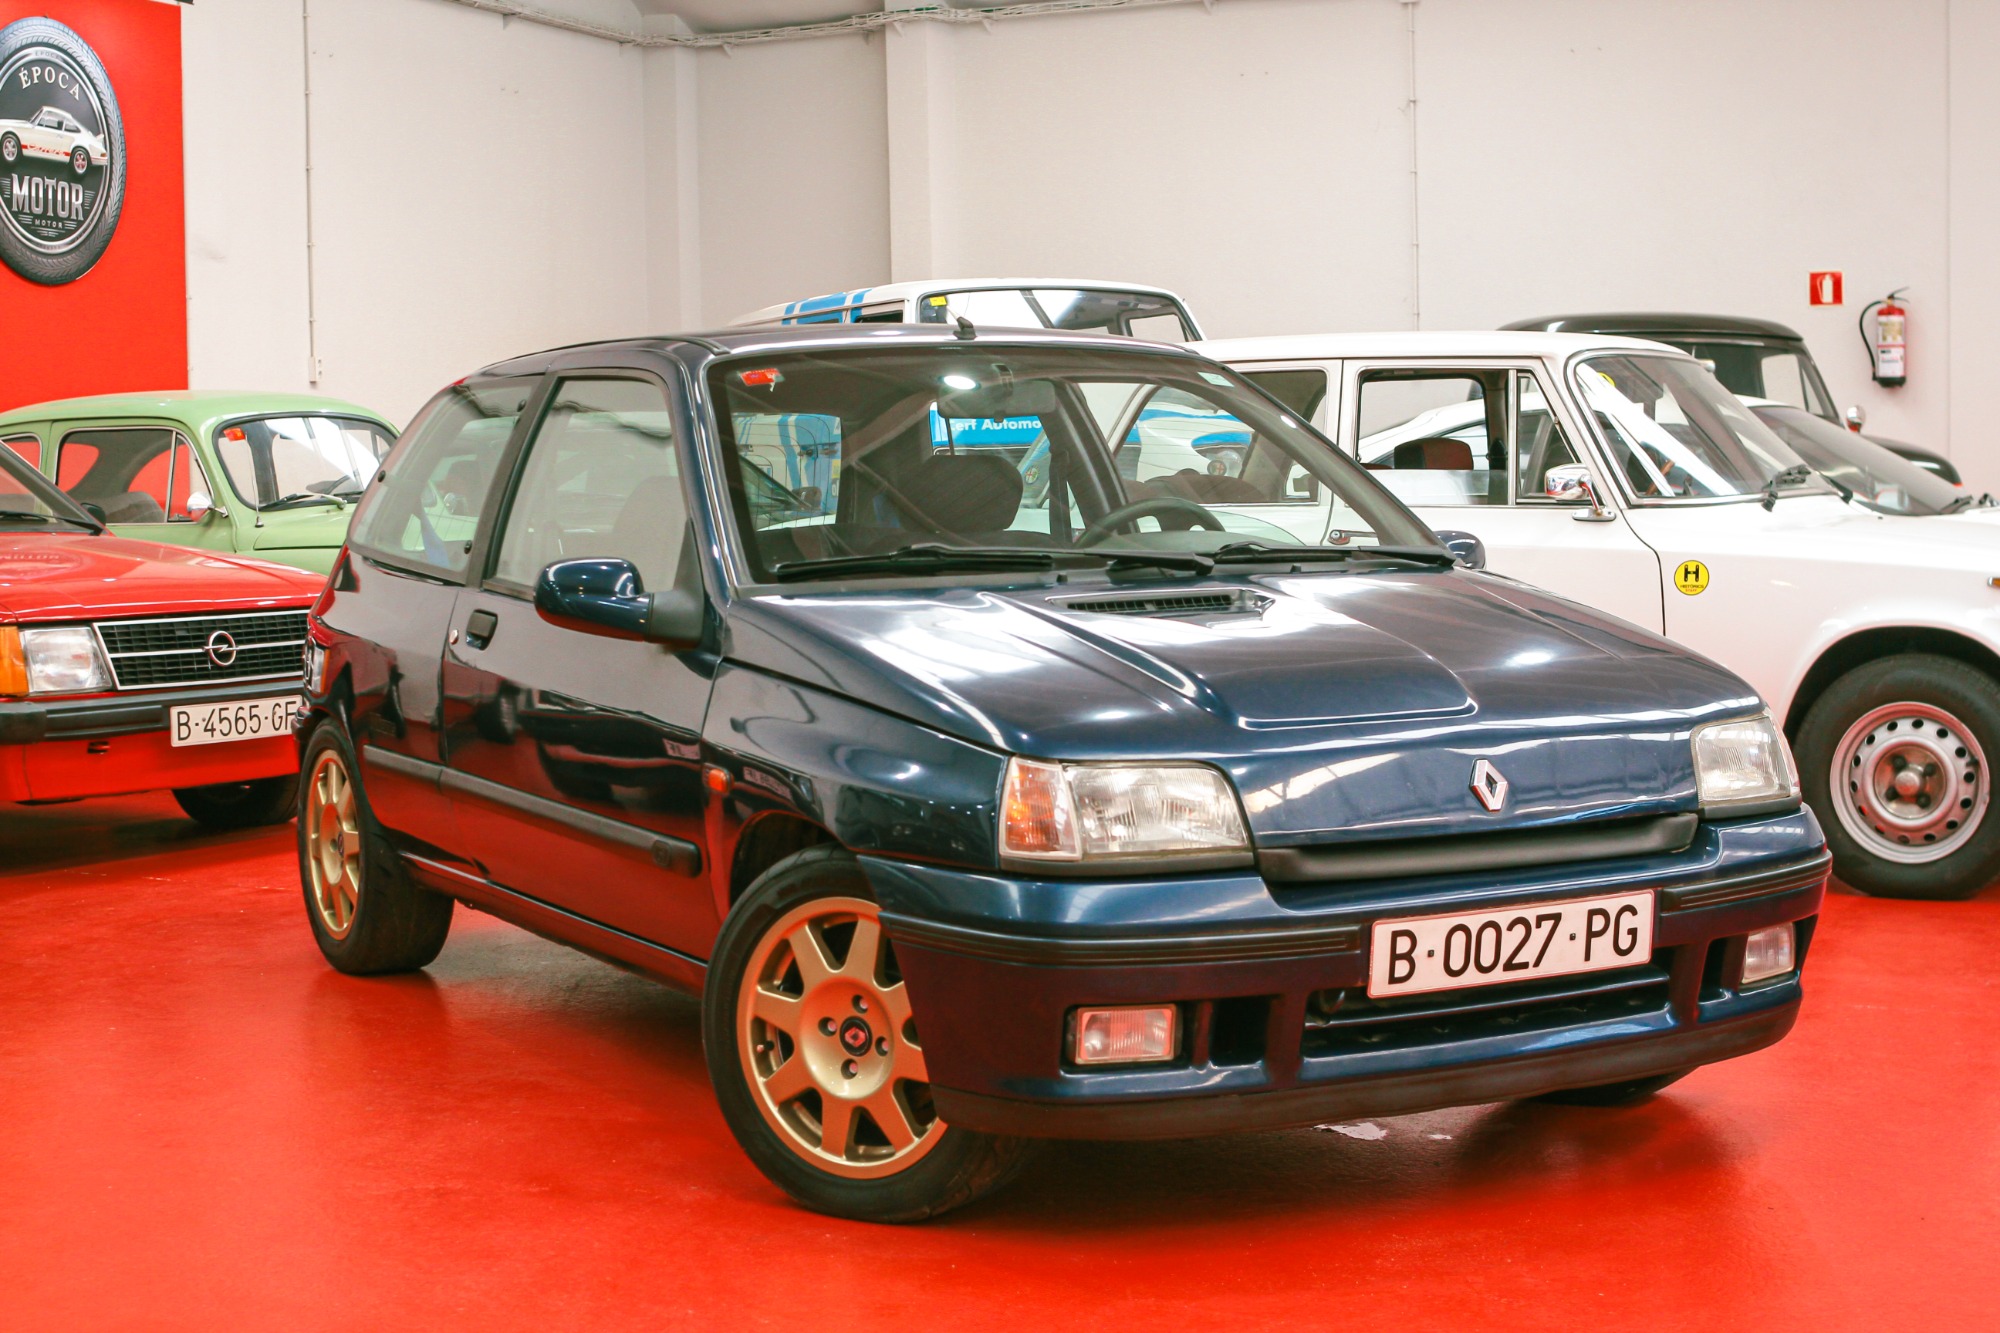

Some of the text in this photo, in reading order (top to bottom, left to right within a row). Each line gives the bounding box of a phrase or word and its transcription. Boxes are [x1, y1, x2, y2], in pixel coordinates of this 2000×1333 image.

[19, 66, 80, 100] ÉPOCA
[12, 173, 84, 220] MOTOR
[35, 218, 63, 229] MOTOR
[1684, 564, 1699, 582] H
